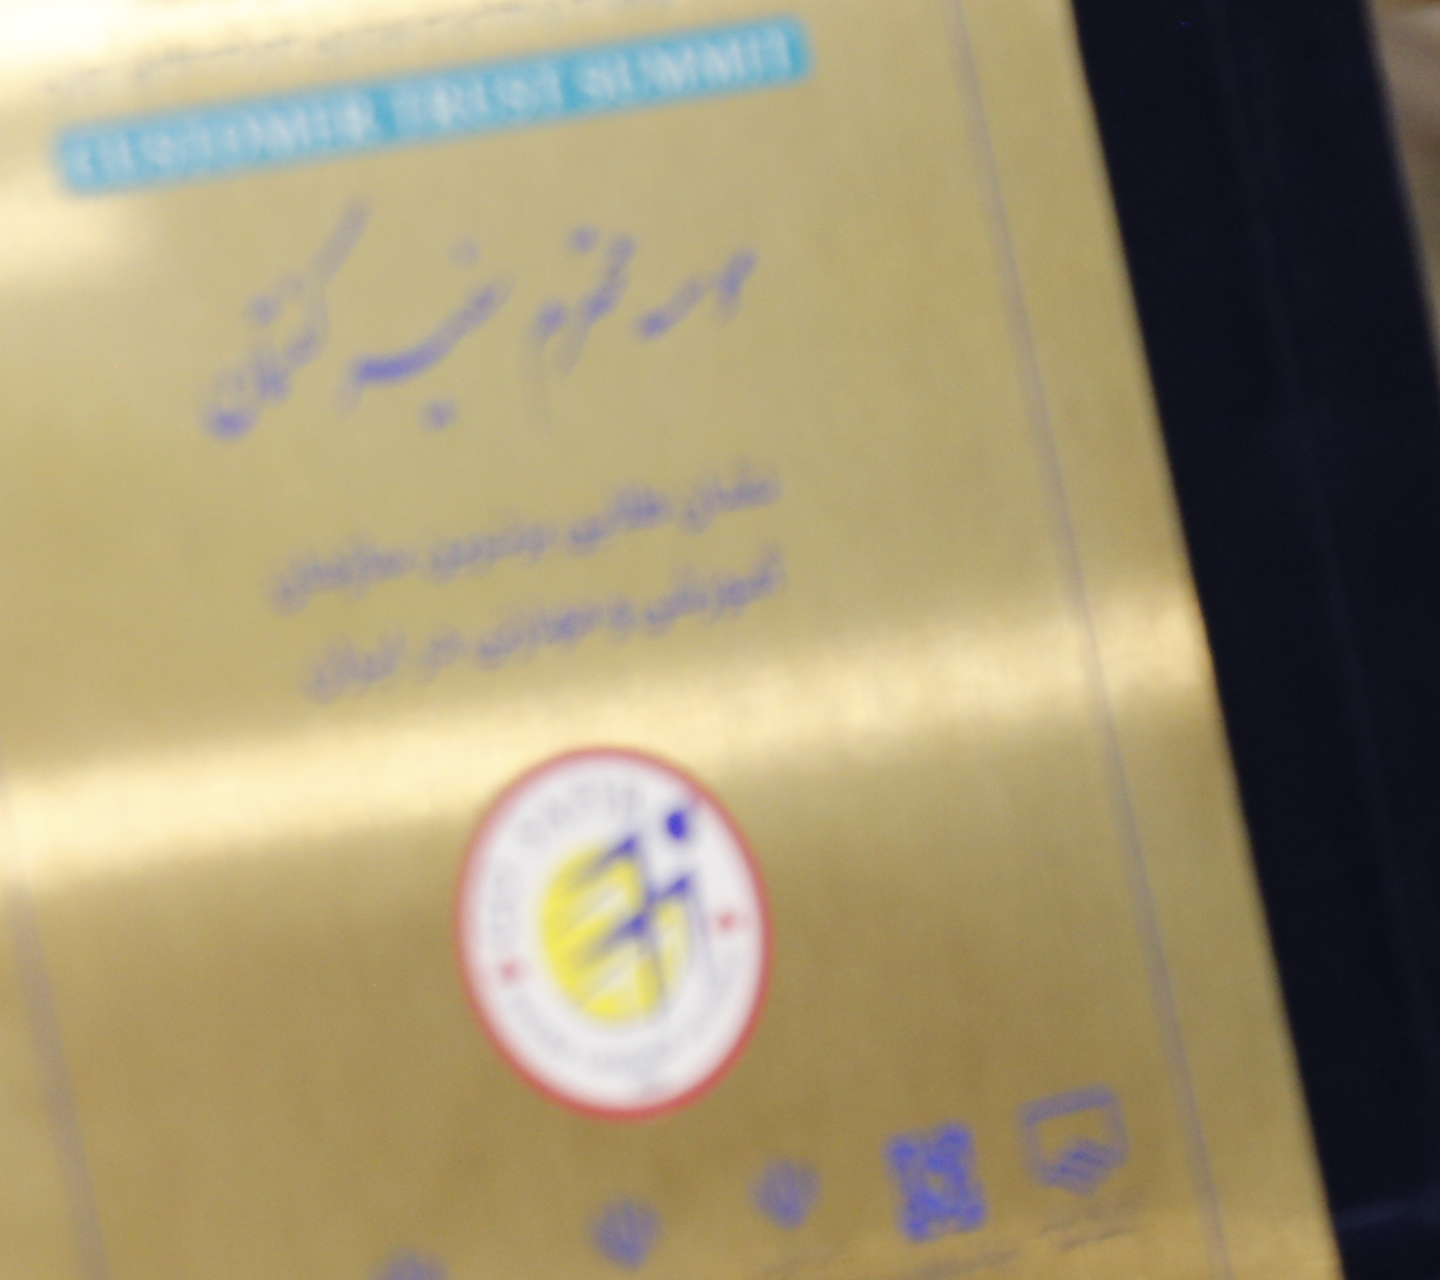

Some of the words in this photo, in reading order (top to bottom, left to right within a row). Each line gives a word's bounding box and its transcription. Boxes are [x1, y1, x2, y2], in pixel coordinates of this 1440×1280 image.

[68, 92, 382, 180] CUSTOMER
[392, 58, 564, 134] TRUST
[578, 24, 792, 102] SUMMIT
